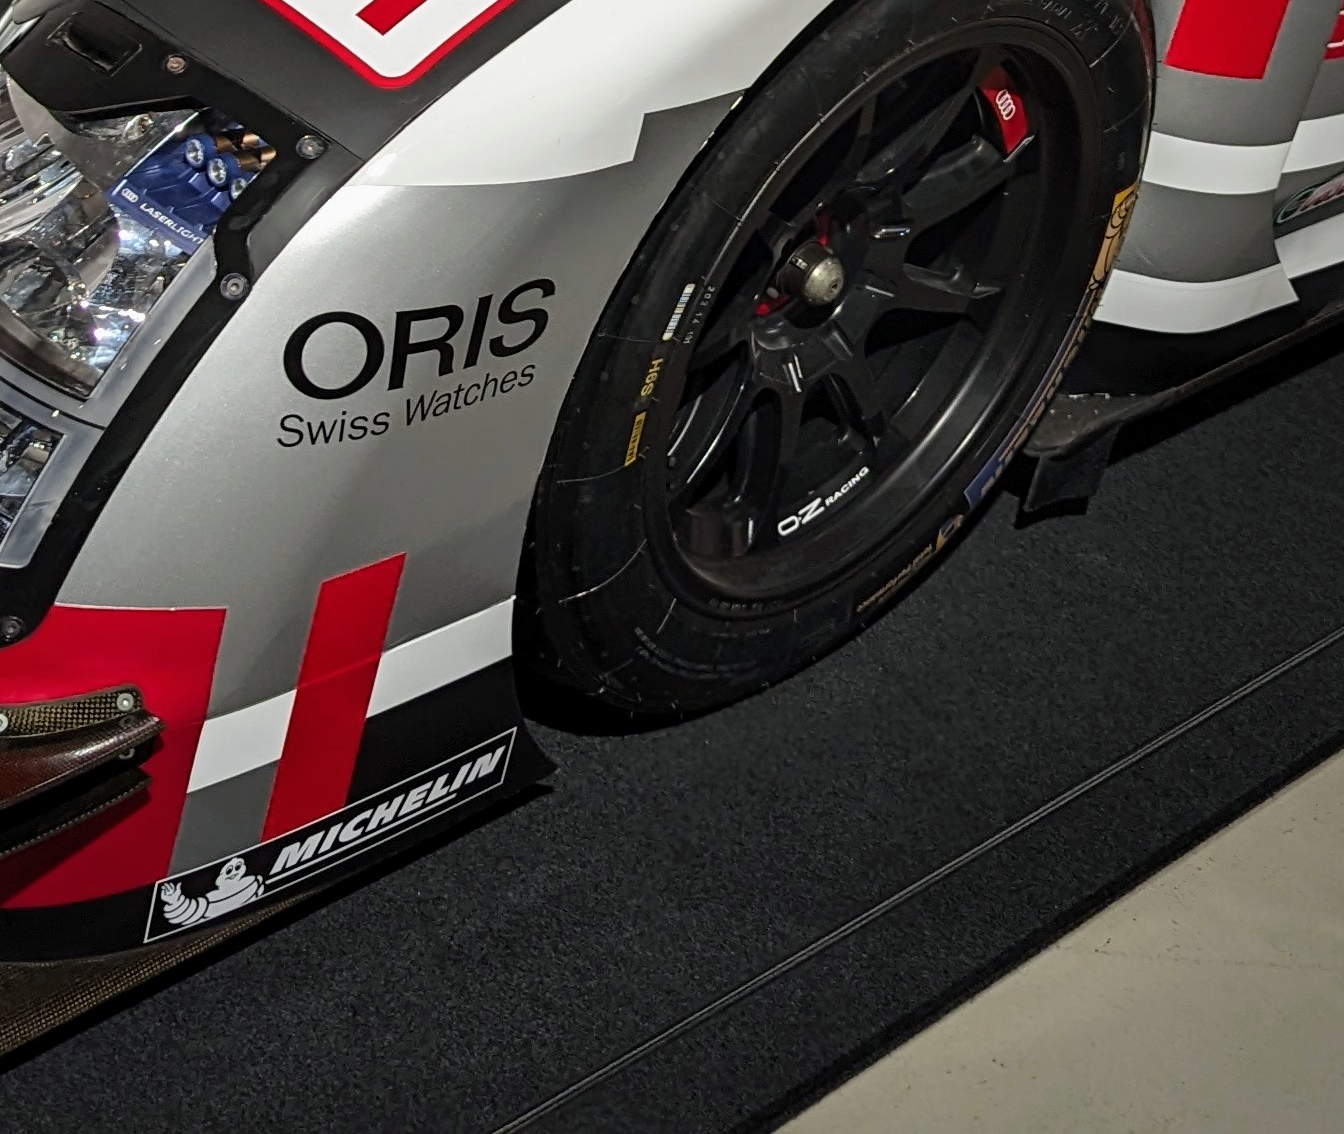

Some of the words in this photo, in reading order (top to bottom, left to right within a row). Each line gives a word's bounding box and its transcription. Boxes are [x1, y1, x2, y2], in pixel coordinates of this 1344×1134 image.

[283, 278, 556, 400] ORIS
[276, 410, 391, 448] Swiss
[406, 363, 536, 426] Watches
[824, 466, 870, 506] RACING
[269, 744, 507, 875] MICHELIN
